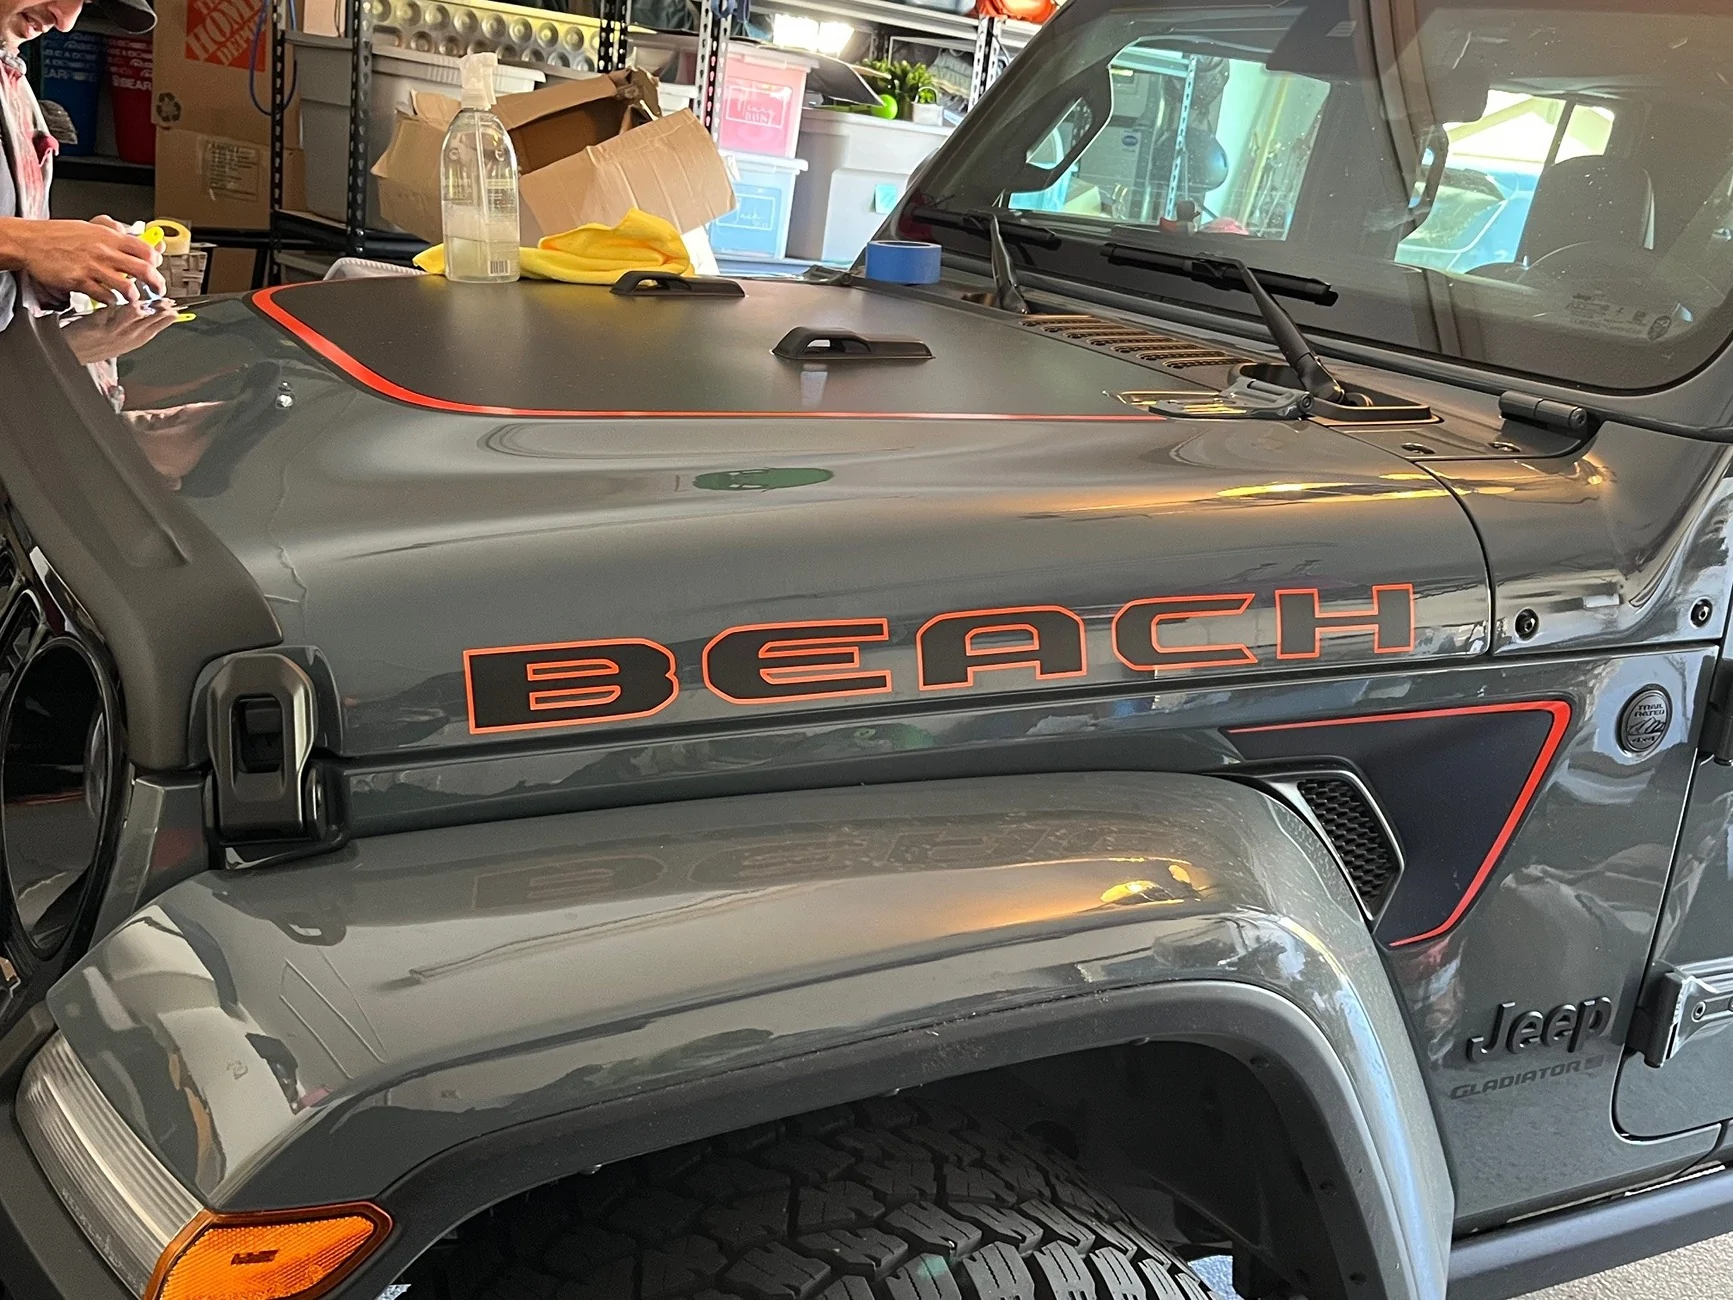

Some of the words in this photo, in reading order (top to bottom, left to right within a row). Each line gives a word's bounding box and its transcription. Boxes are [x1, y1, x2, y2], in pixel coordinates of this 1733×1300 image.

[464, 583, 1416, 735] BEACH
[1634, 709, 1665, 717] RATED
[1638, 703, 1664, 711] TRAIL
[1466, 997, 1611, 1062] Jeep
[1450, 1060, 1581, 1099] GLADIATOR
